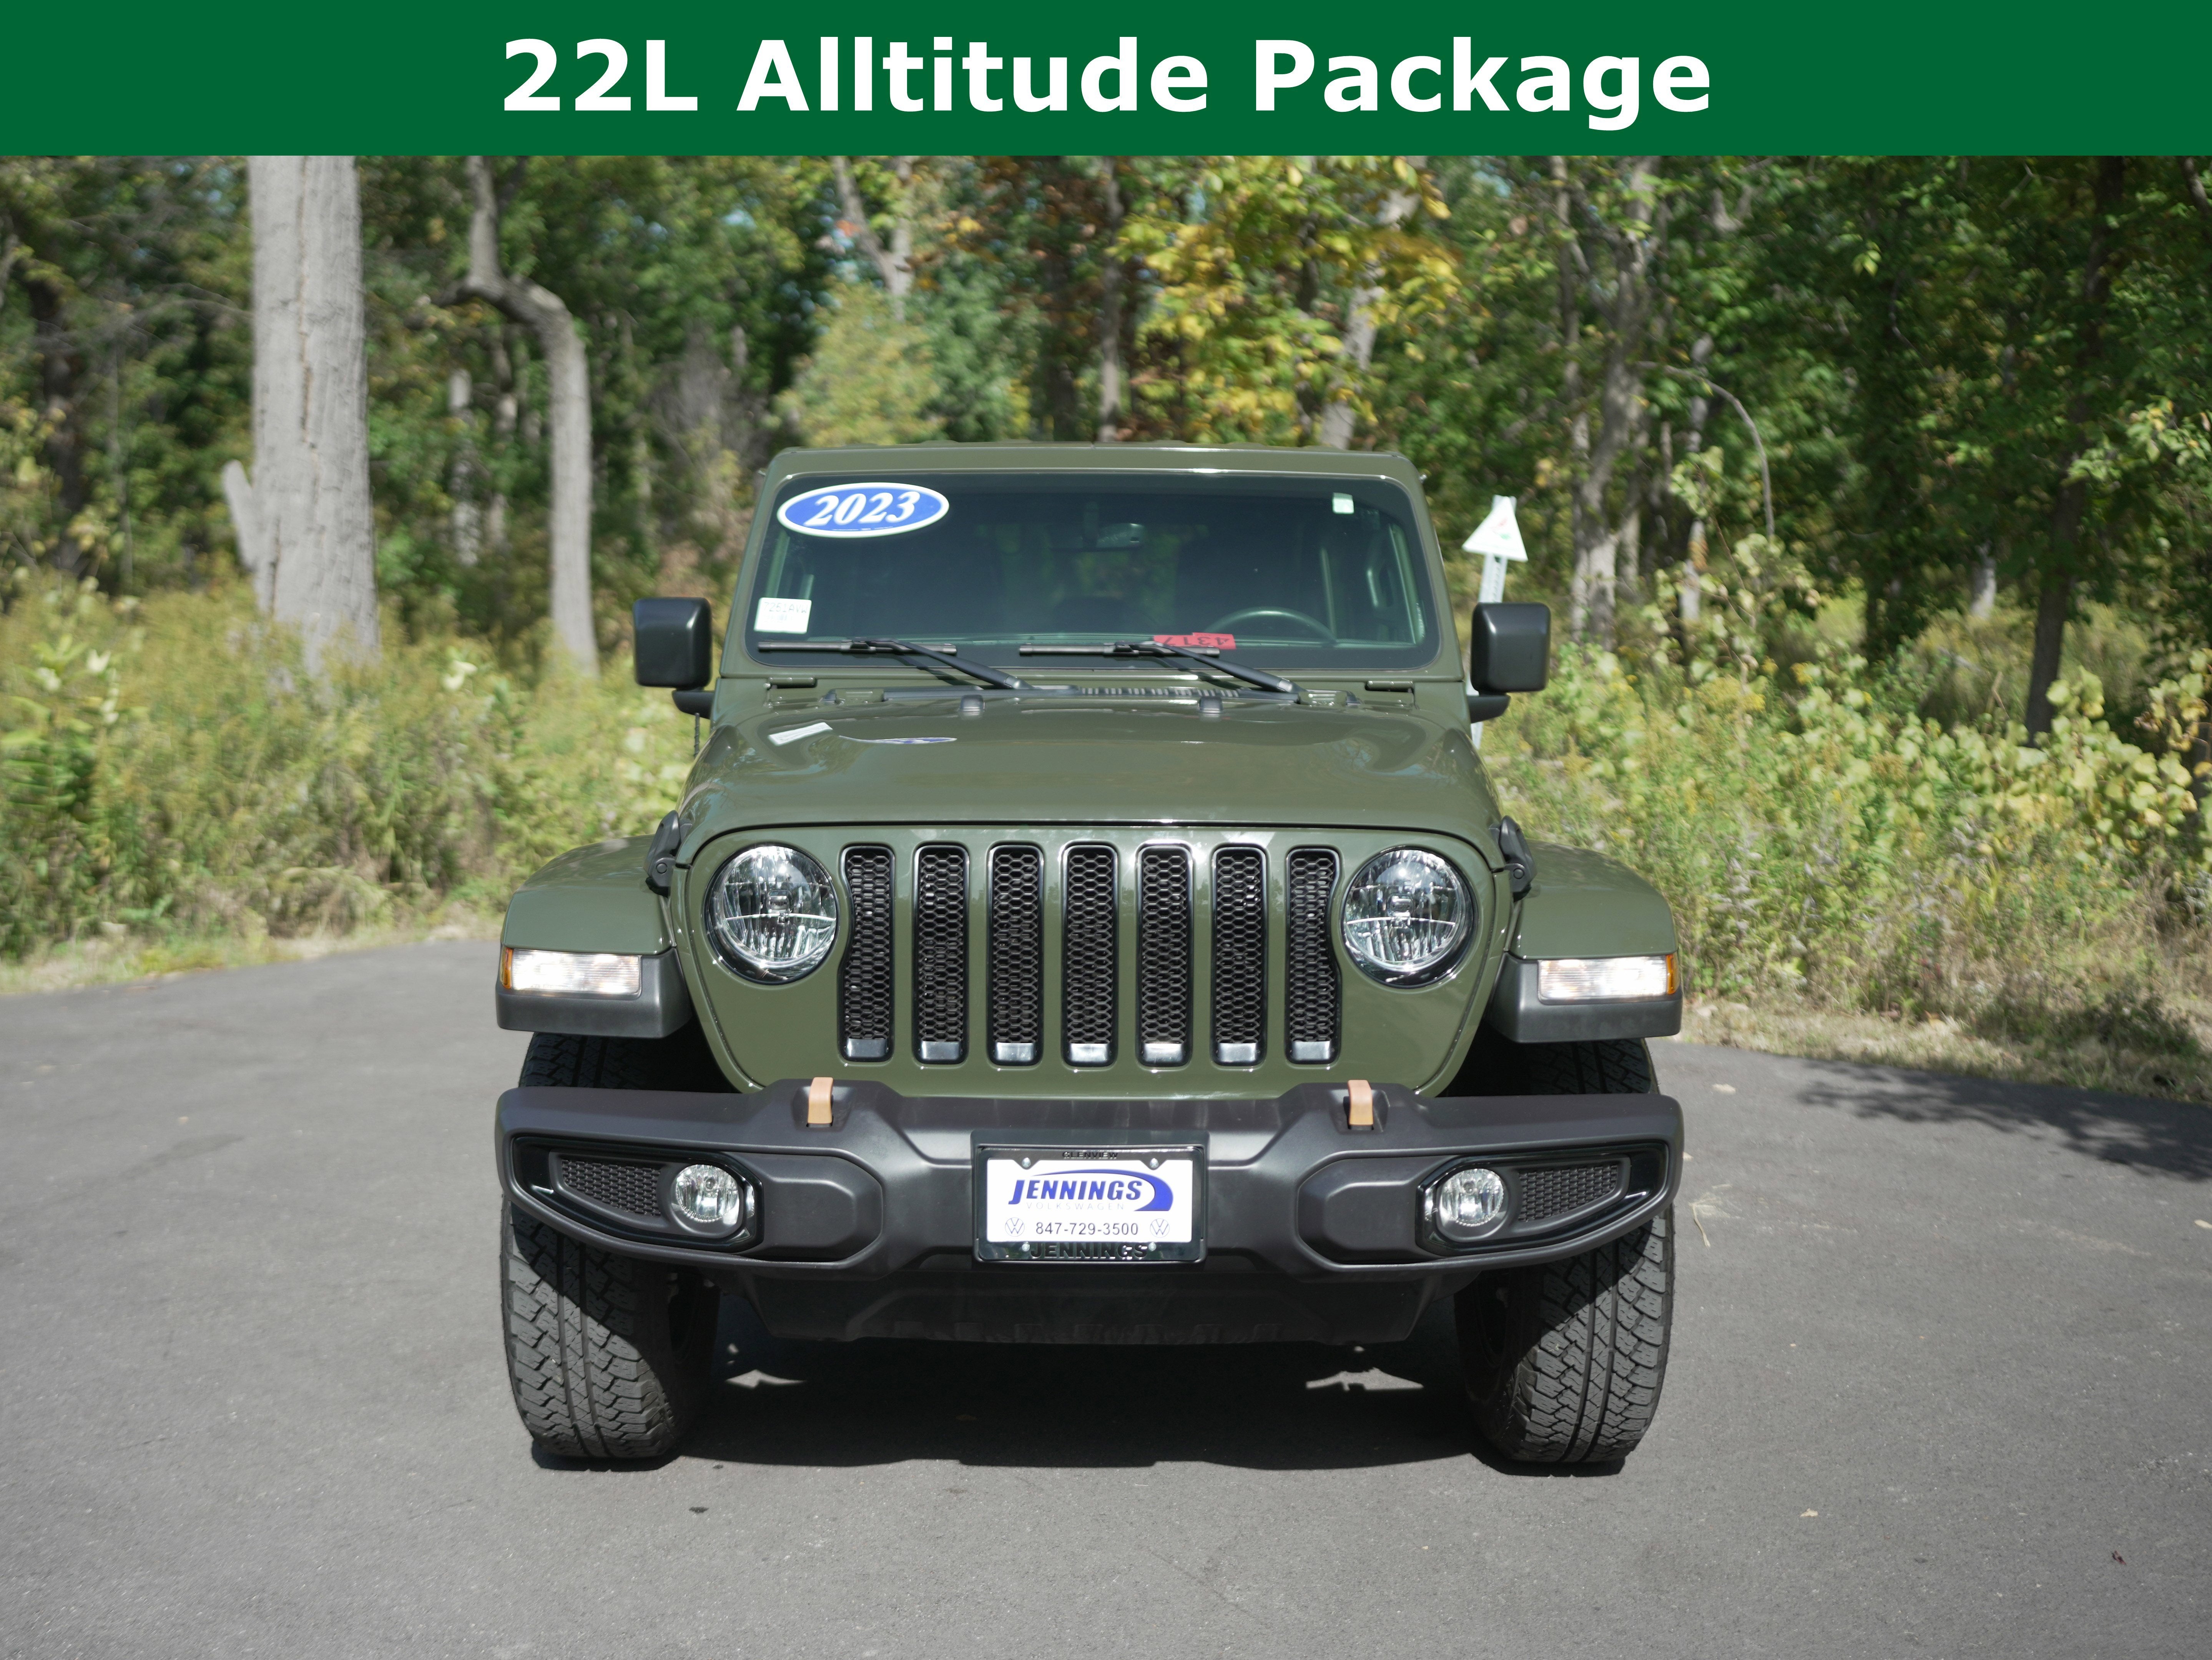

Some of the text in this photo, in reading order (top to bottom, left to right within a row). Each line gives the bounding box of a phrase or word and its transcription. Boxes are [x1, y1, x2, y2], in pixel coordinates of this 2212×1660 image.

[803, 491, 921, 526] 2023
[1008, 1180, 1142, 1205] JENNINGS
[1036, 1222, 1138, 1235] 847-729-3500
[1030, 1242, 1148, 1260] JENNINGS
